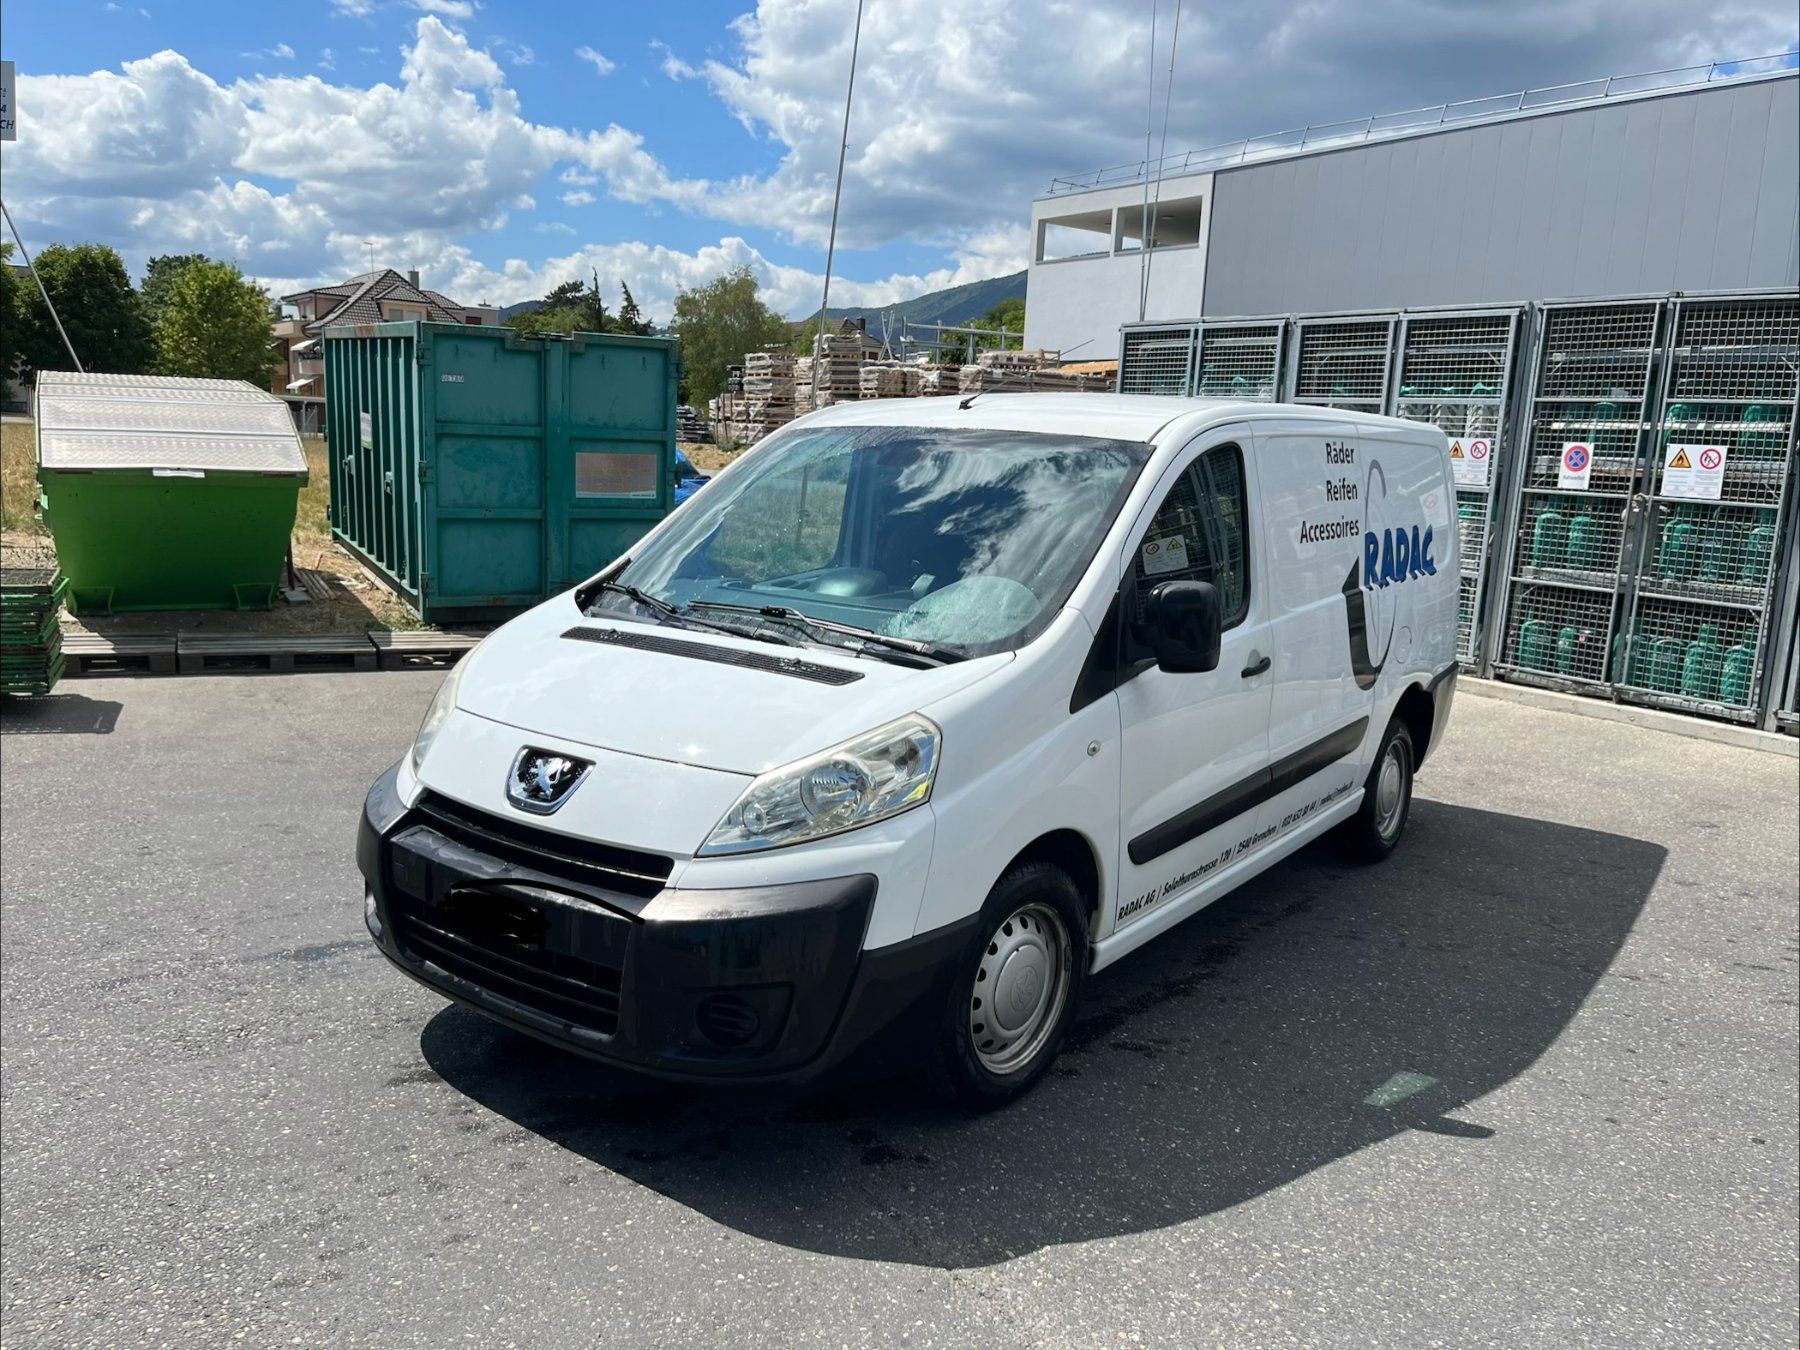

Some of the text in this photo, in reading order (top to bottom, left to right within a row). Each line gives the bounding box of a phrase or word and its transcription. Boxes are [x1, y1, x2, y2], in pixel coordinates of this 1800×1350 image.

[1326, 442, 1355, 465] Räder
[1326, 478, 1358, 502] Reifen
[1300, 516, 1360, 544] Accessoires
[1363, 524, 1437, 591] RADAC
[1117, 895, 1145, 921] RADAC
[1144, 889, 1156, 906] AG
